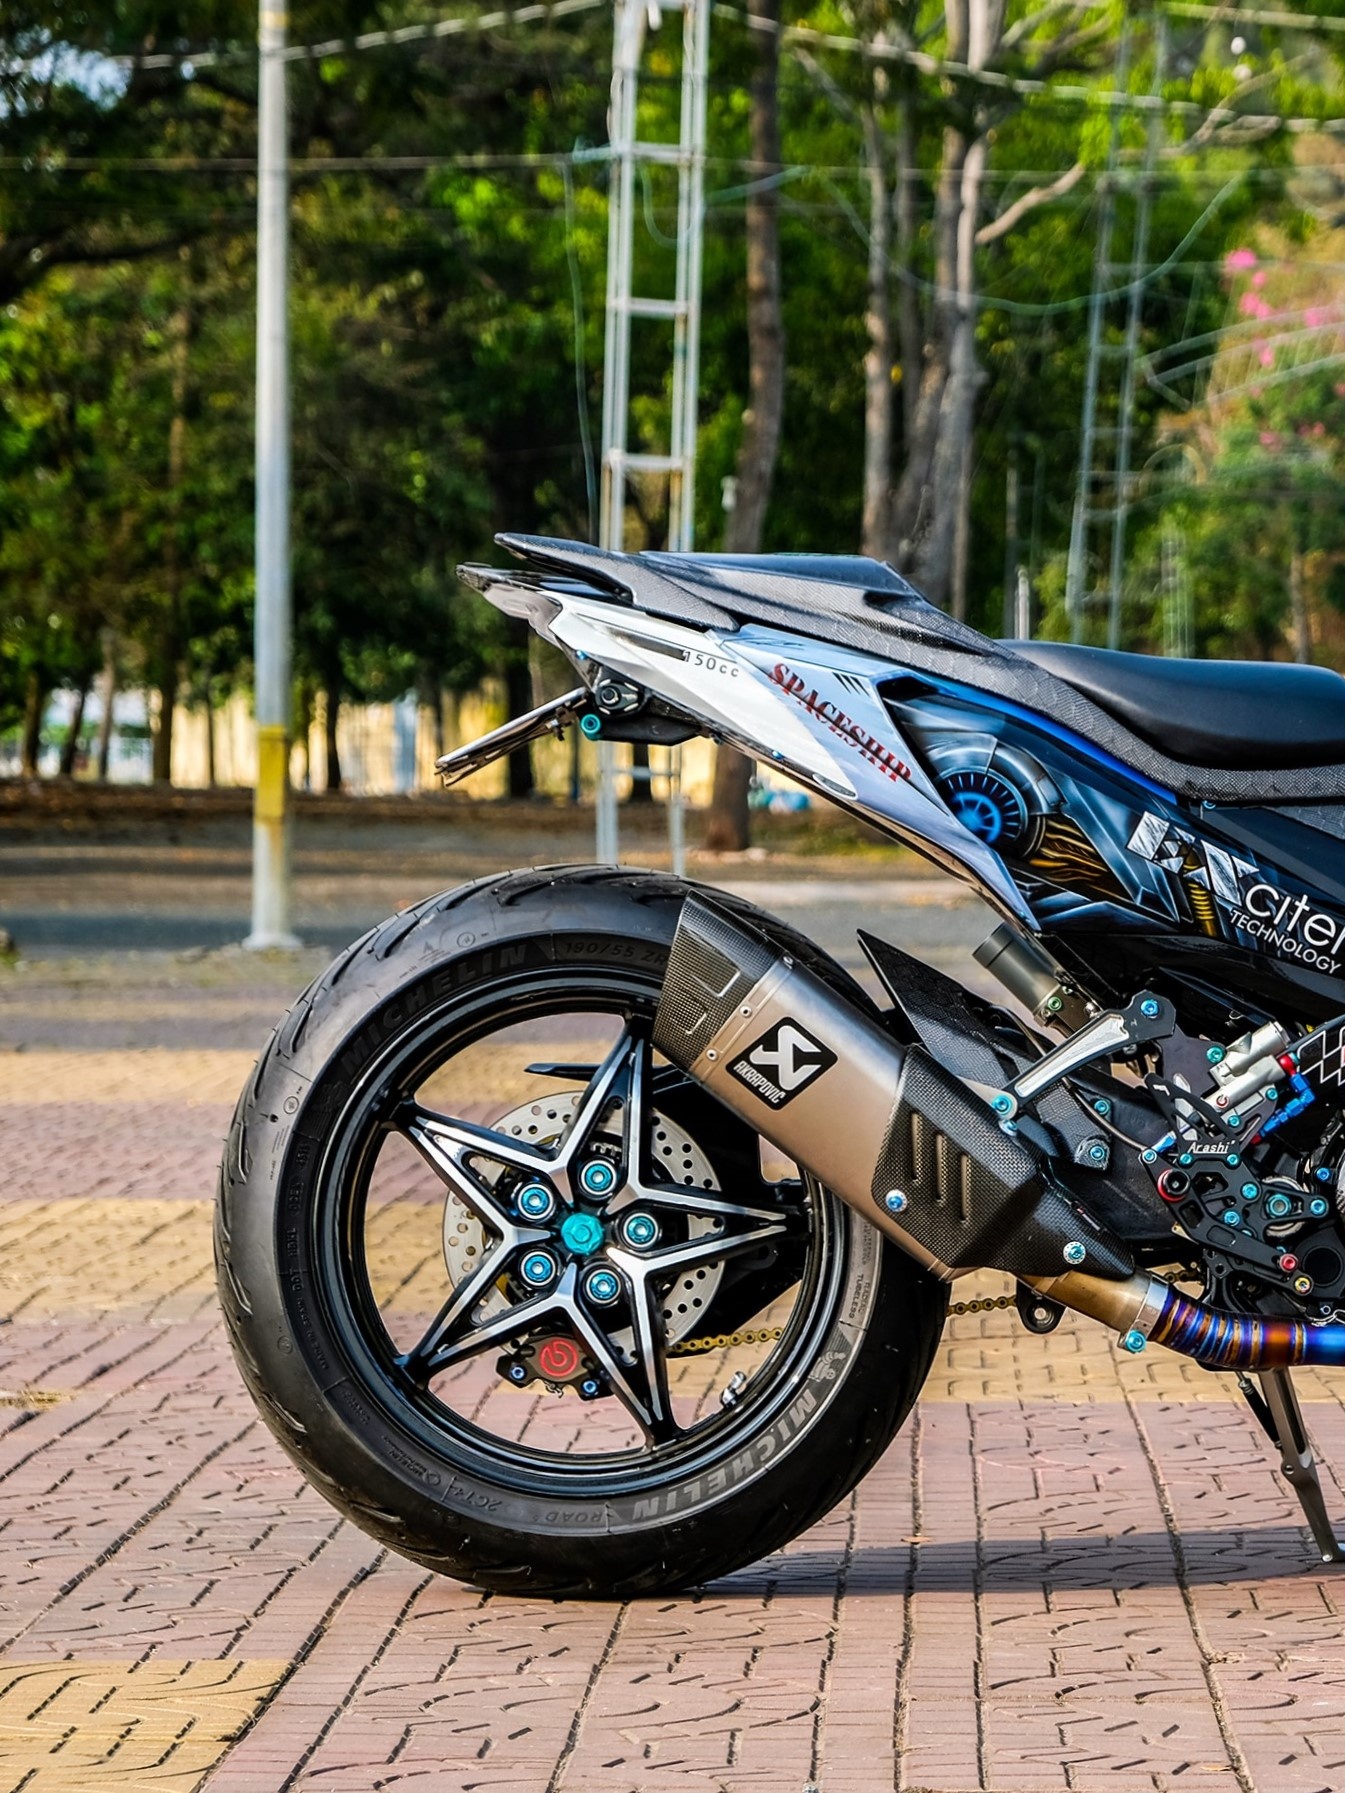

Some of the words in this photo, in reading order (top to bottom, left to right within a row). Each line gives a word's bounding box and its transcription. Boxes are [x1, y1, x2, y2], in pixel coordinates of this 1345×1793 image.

[683, 650, 740, 678] 150cc
[767, 662, 913, 783] SPACESHIP
[1229, 908, 1342, 975] TECHNOLOGY
[336, 940, 530, 1078] MICHELIN
[1187, 1140, 1230, 1153] Arashi
[846, 1271, 864, 1319] TUBELESS
[628, 1387, 822, 1519] MICHELIN
[543, 1509, 603, 1523] ROAD
